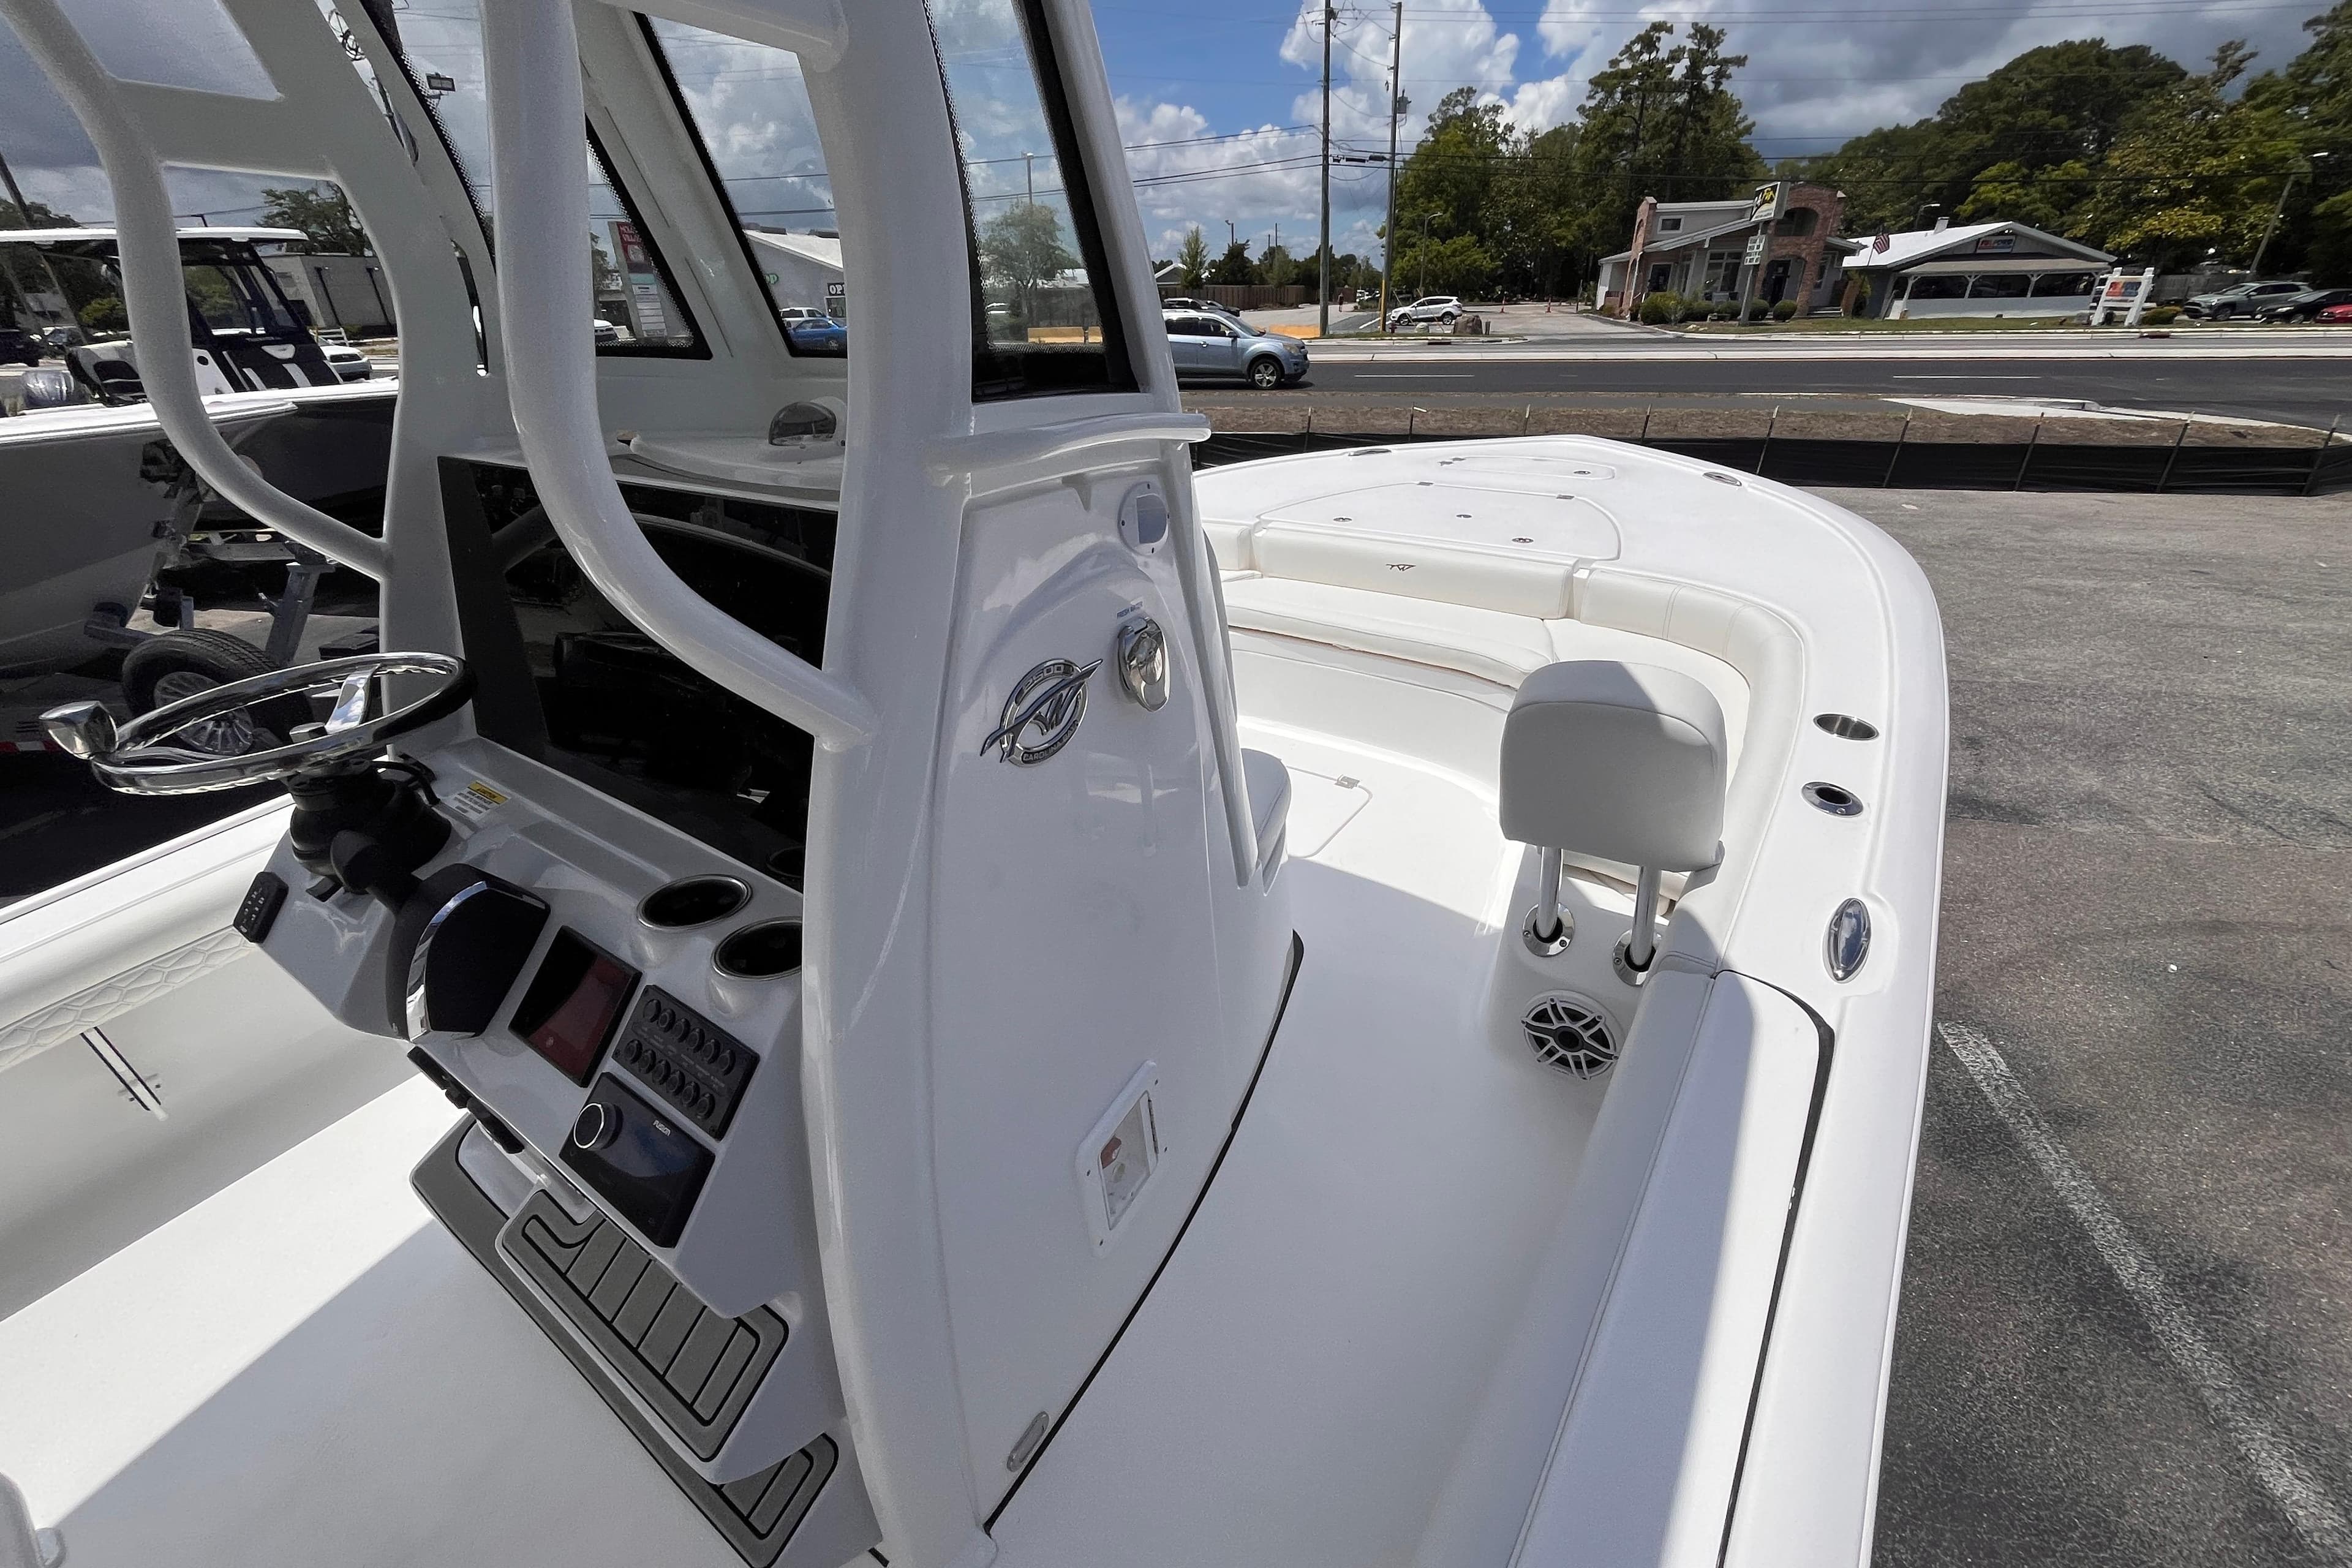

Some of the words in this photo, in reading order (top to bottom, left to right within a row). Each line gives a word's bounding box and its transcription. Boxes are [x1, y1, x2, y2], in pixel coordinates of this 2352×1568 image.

[1023, 665, 1065, 691] 2500
[1022, 741, 1062, 761] CAROLINA
[653, 1120, 671, 1136] FUSION
